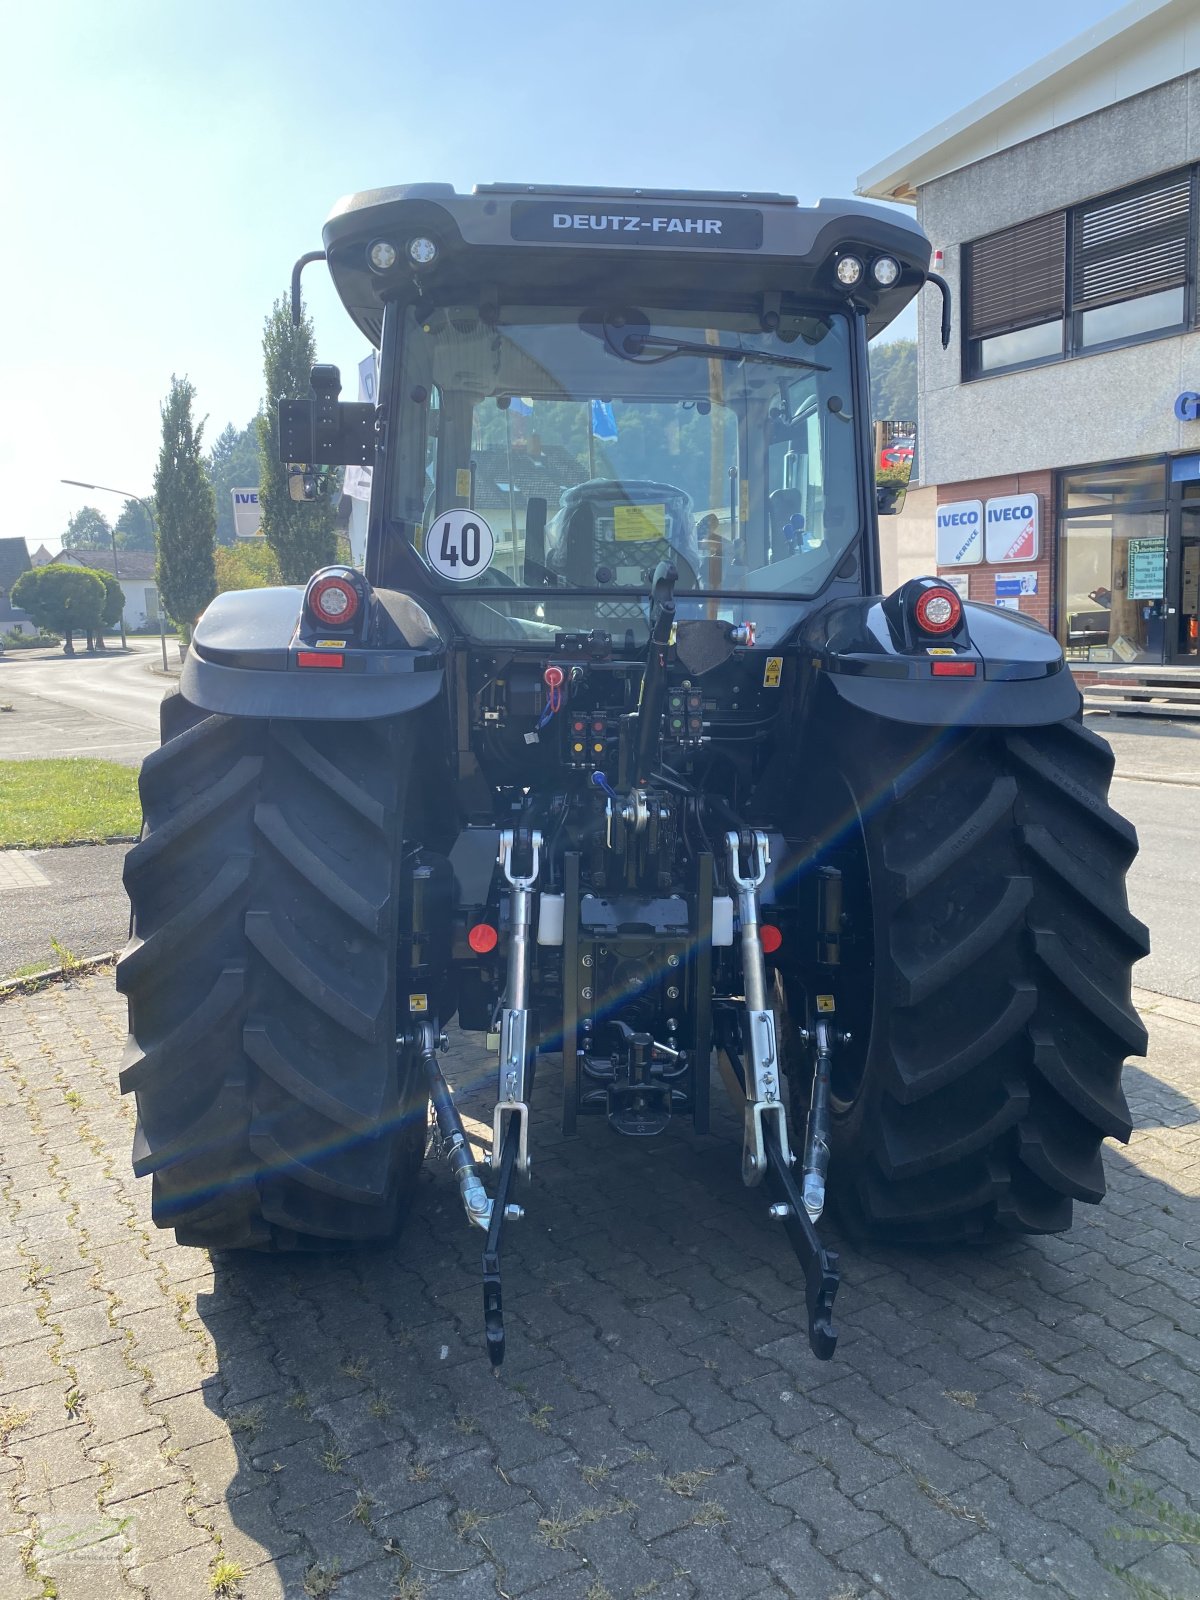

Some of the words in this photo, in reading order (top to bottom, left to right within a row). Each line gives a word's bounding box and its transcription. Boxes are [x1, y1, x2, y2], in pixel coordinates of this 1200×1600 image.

[553, 213, 722, 234] DEUTZ-FAHR
[235, 493, 259, 504] IVE
[937, 511, 979, 528] IVECO
[988, 505, 1033, 523] IVECO
[440, 522, 480, 567] 40
[955, 529, 979, 562] SERVICE
[1007, 524, 1034, 558] PARTS
